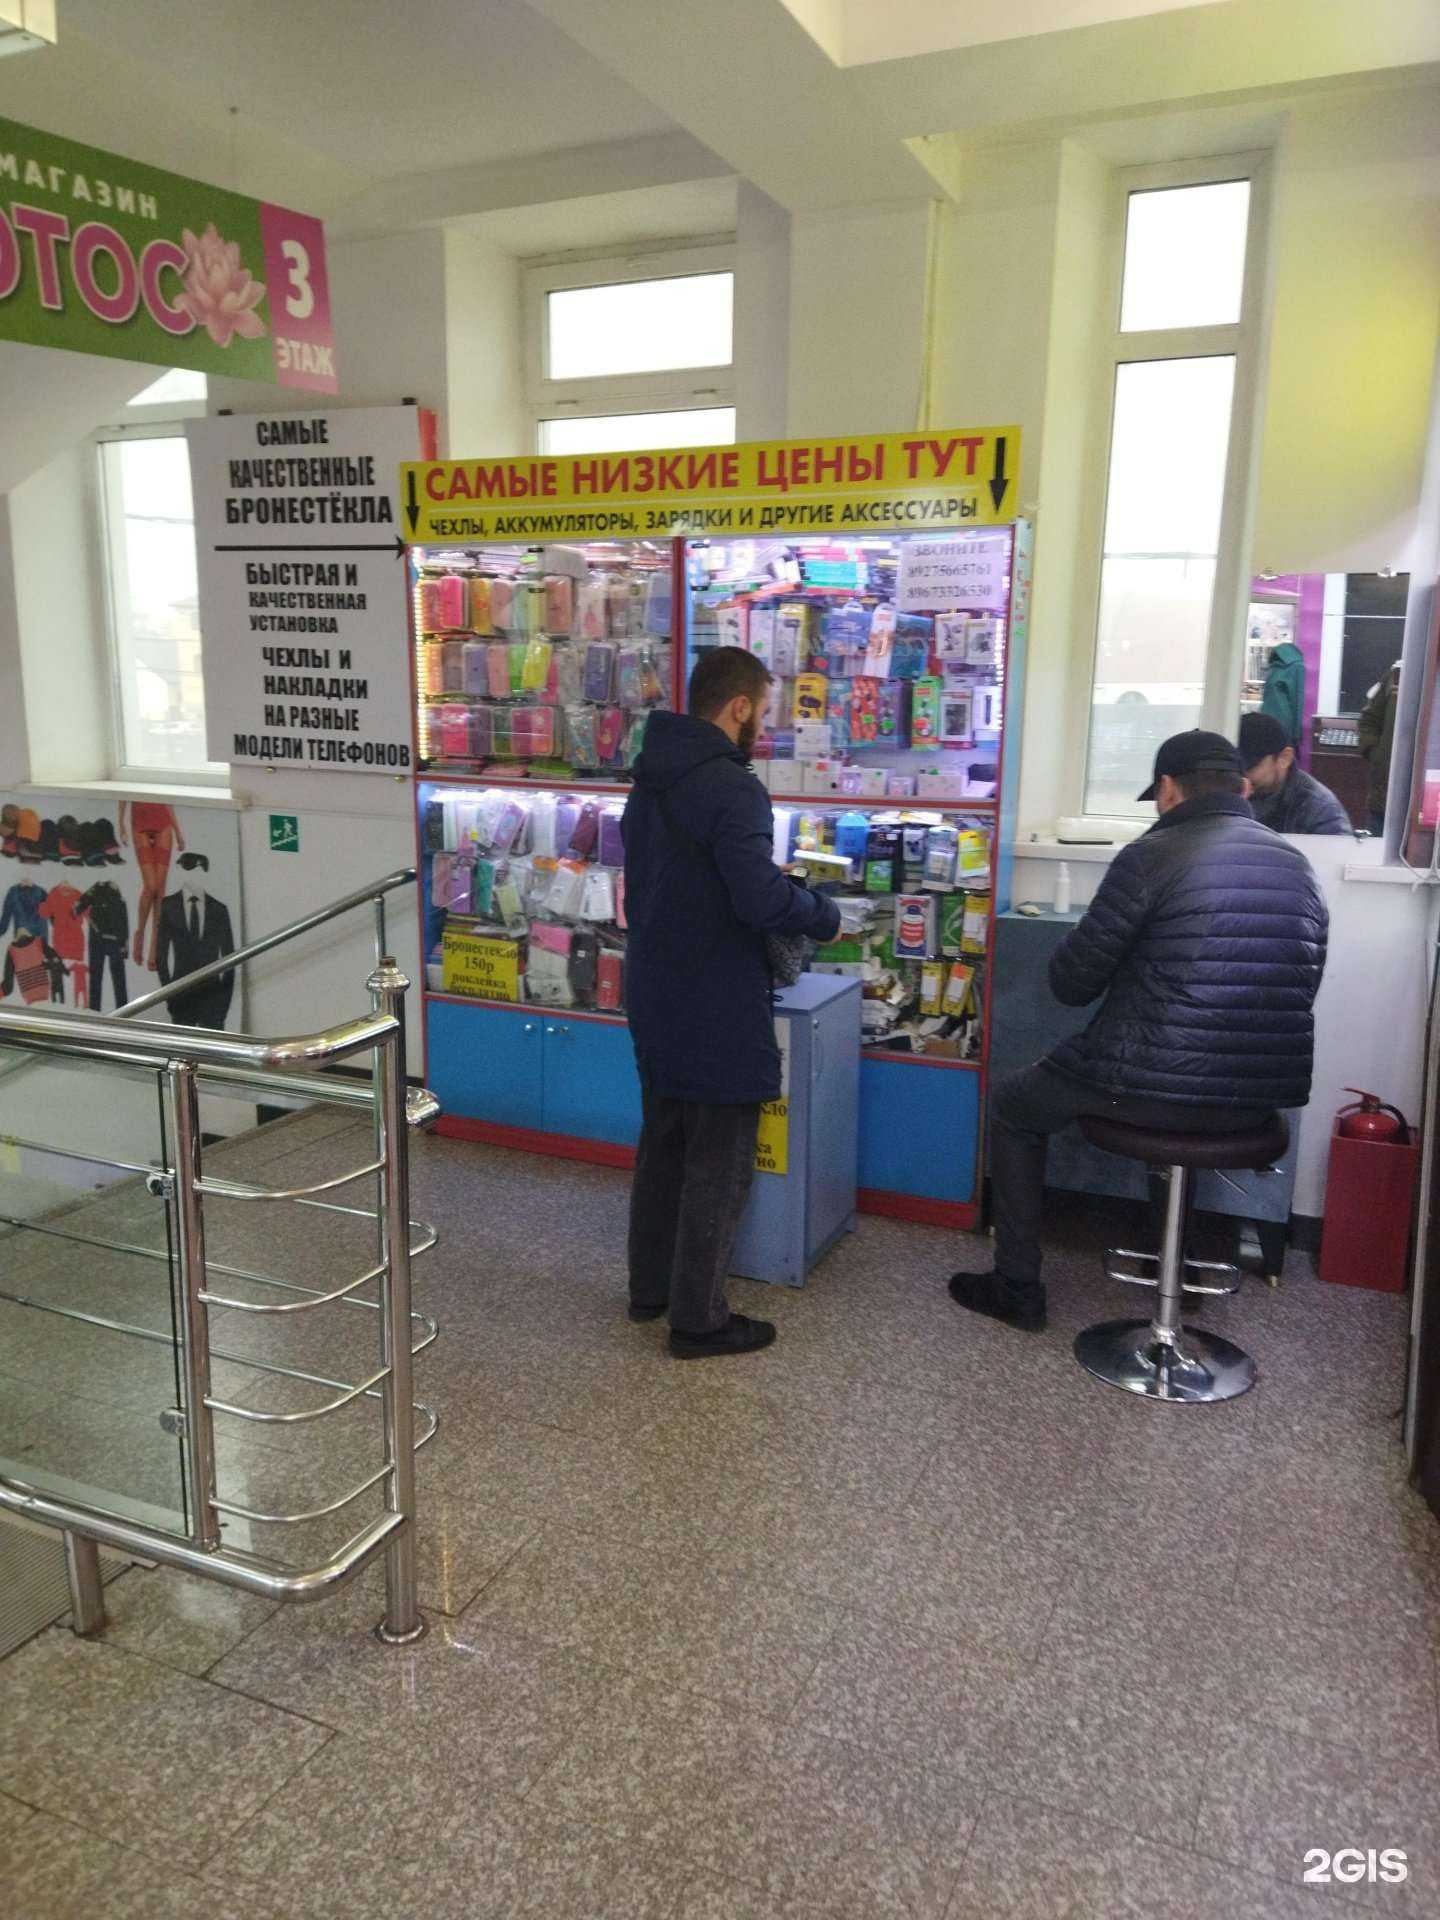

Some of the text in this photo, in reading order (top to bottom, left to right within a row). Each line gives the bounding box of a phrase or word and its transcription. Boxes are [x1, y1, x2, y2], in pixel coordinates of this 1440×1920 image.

[0, 152, 158, 220] МАГАЗИН
[281, 239, 314, 319] 3
[276, 337, 334, 376] ЭТАЖ
[256, 419, 329, 446] САМЫЕ
[229, 456, 375, 488] КАЧЕСТВЕННЫЕ
[425, 437, 985, 501] САМЫЕ НИЗКИЕ ЦЕНЫ ТУТ
[225, 491, 393, 524] БРОНЕСТЁКЛА
[429, 498, 977, 537] ЧЕХЛЫ, АККУМУЛЯТОРЫ, ЗАРЯДКИ И ДРУГИЕ АКСЕССУАРЫ
[246, 563, 358, 586] БЫСТРАЯ И
[248, 592, 367, 610] КАЧЕСТВЕННАЯ
[249, 615, 338, 633] УСТАНОВКА
[262, 647, 352, 670] ЧЕХЛЫ И
[264, 676, 369, 701] НАКЛАДКИ
[264, 705, 360, 731] НА РАЗНЫЕ
[234, 734, 411, 767] МОДЕЛИ ТЕЛЕФОНОВ
[464, 956, 495, 975] 150р
